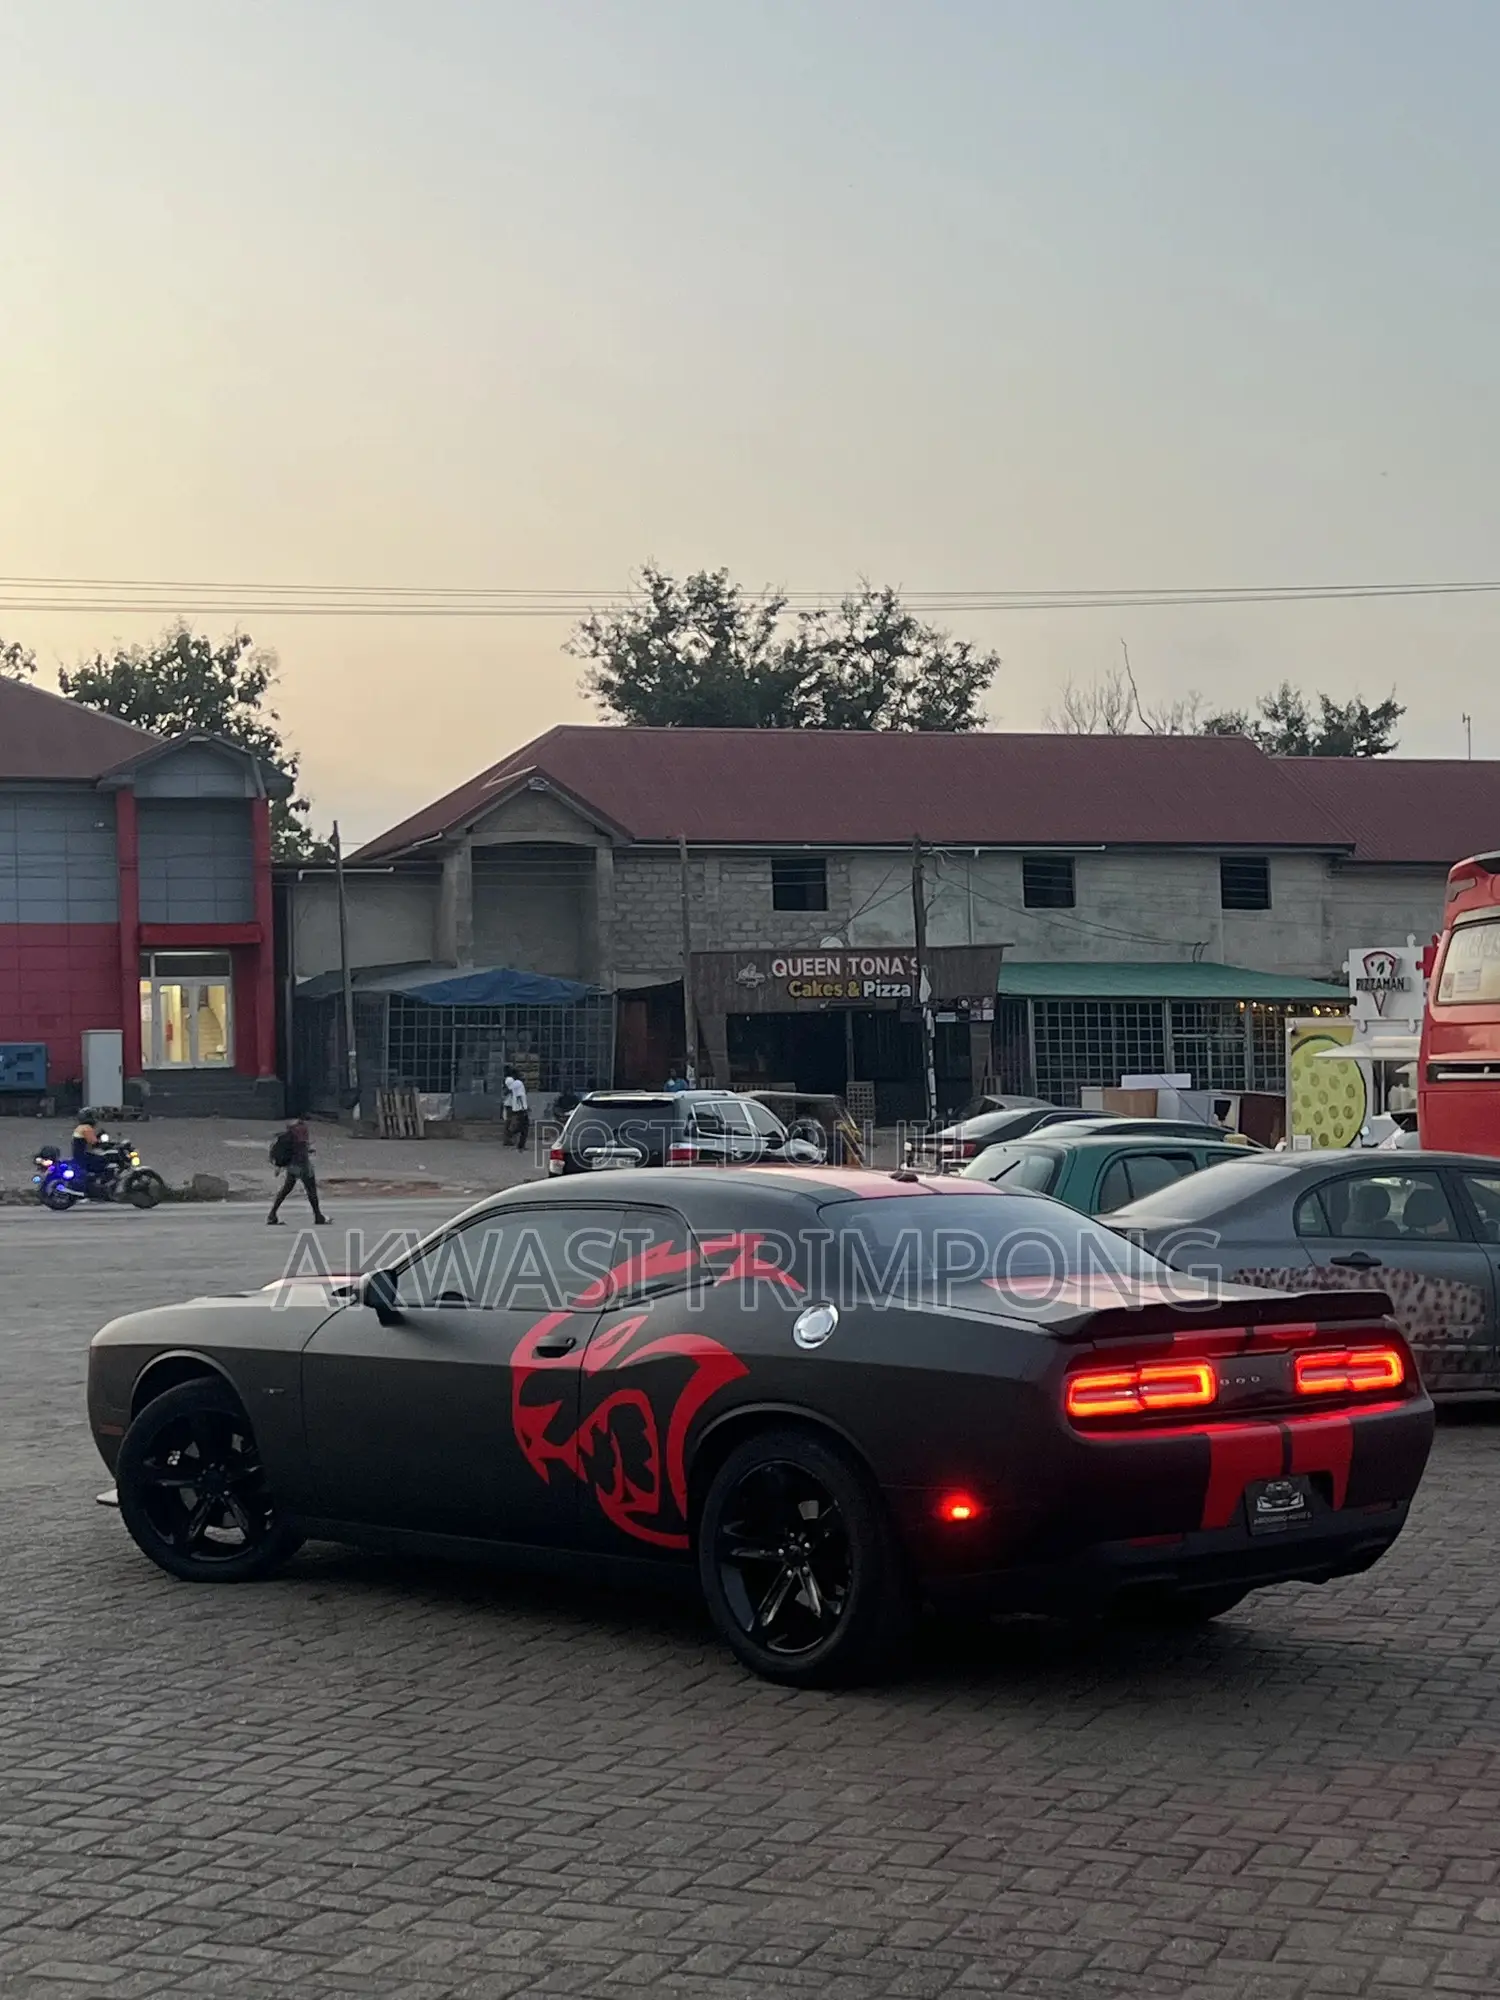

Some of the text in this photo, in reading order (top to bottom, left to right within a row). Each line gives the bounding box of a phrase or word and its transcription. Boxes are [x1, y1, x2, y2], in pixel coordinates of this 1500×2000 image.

[772, 957, 841, 977] QUEEN
[788, 979, 912, 998] Cakes & Pizza
